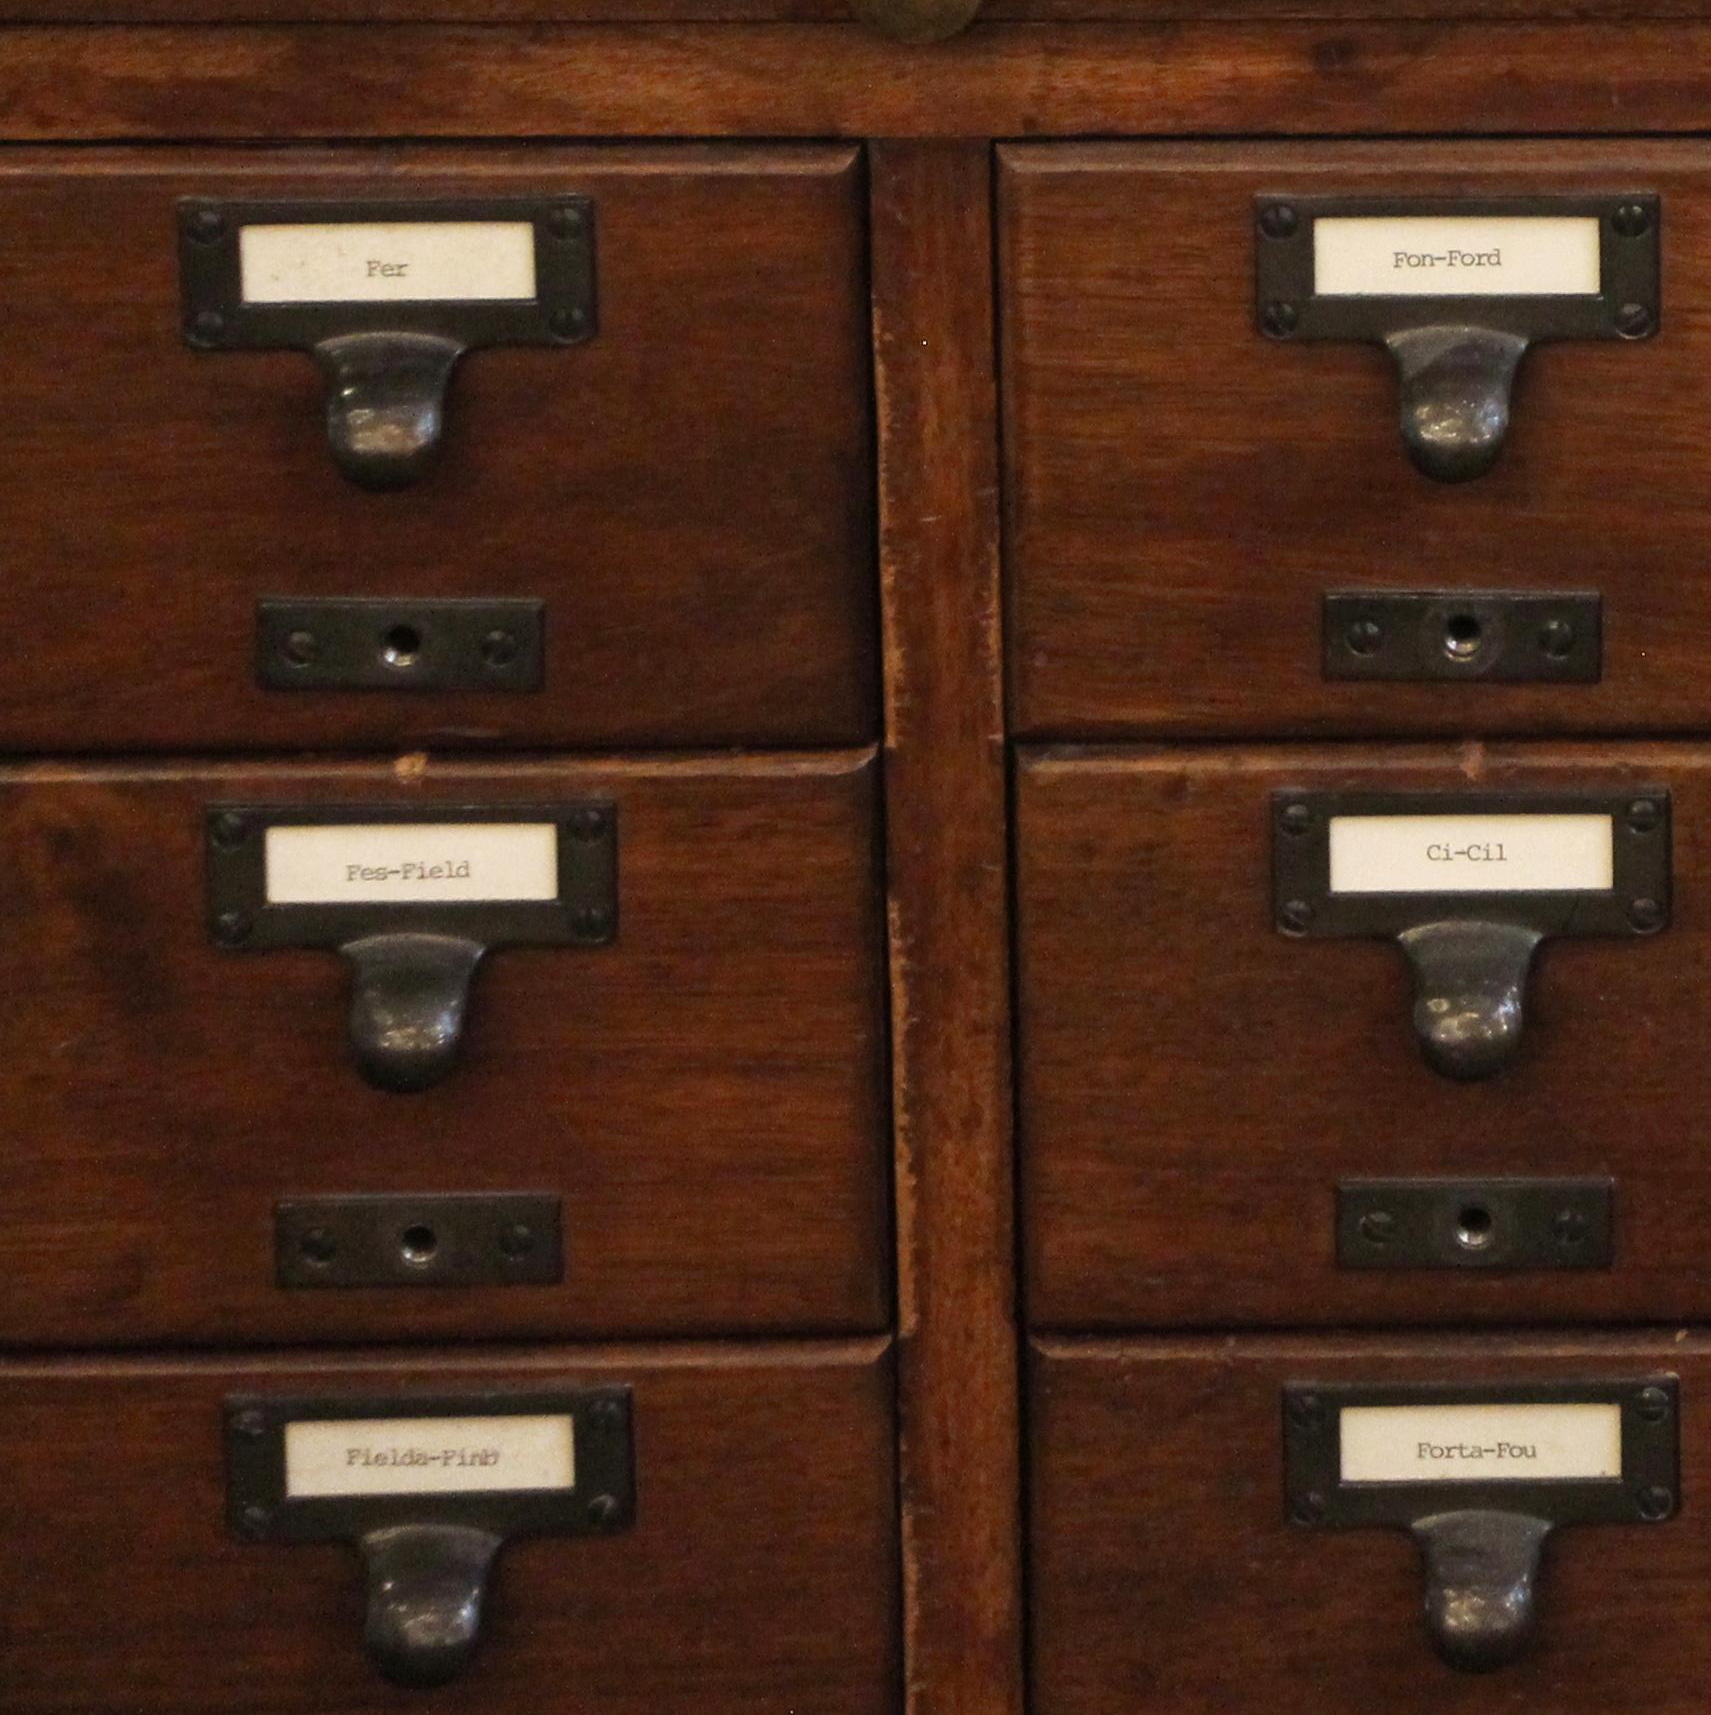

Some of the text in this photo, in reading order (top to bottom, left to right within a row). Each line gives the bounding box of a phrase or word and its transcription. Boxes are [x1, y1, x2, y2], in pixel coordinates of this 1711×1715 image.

[1392, 247, 1503, 269] Fon-Ford
[365, 259, 409, 278] Fer
[1425, 842, 1508, 862] Ci-Cil
[345, 860, 471, 882] Fes-Field
[1416, 1441, 1537, 1460] Forta-Fou
